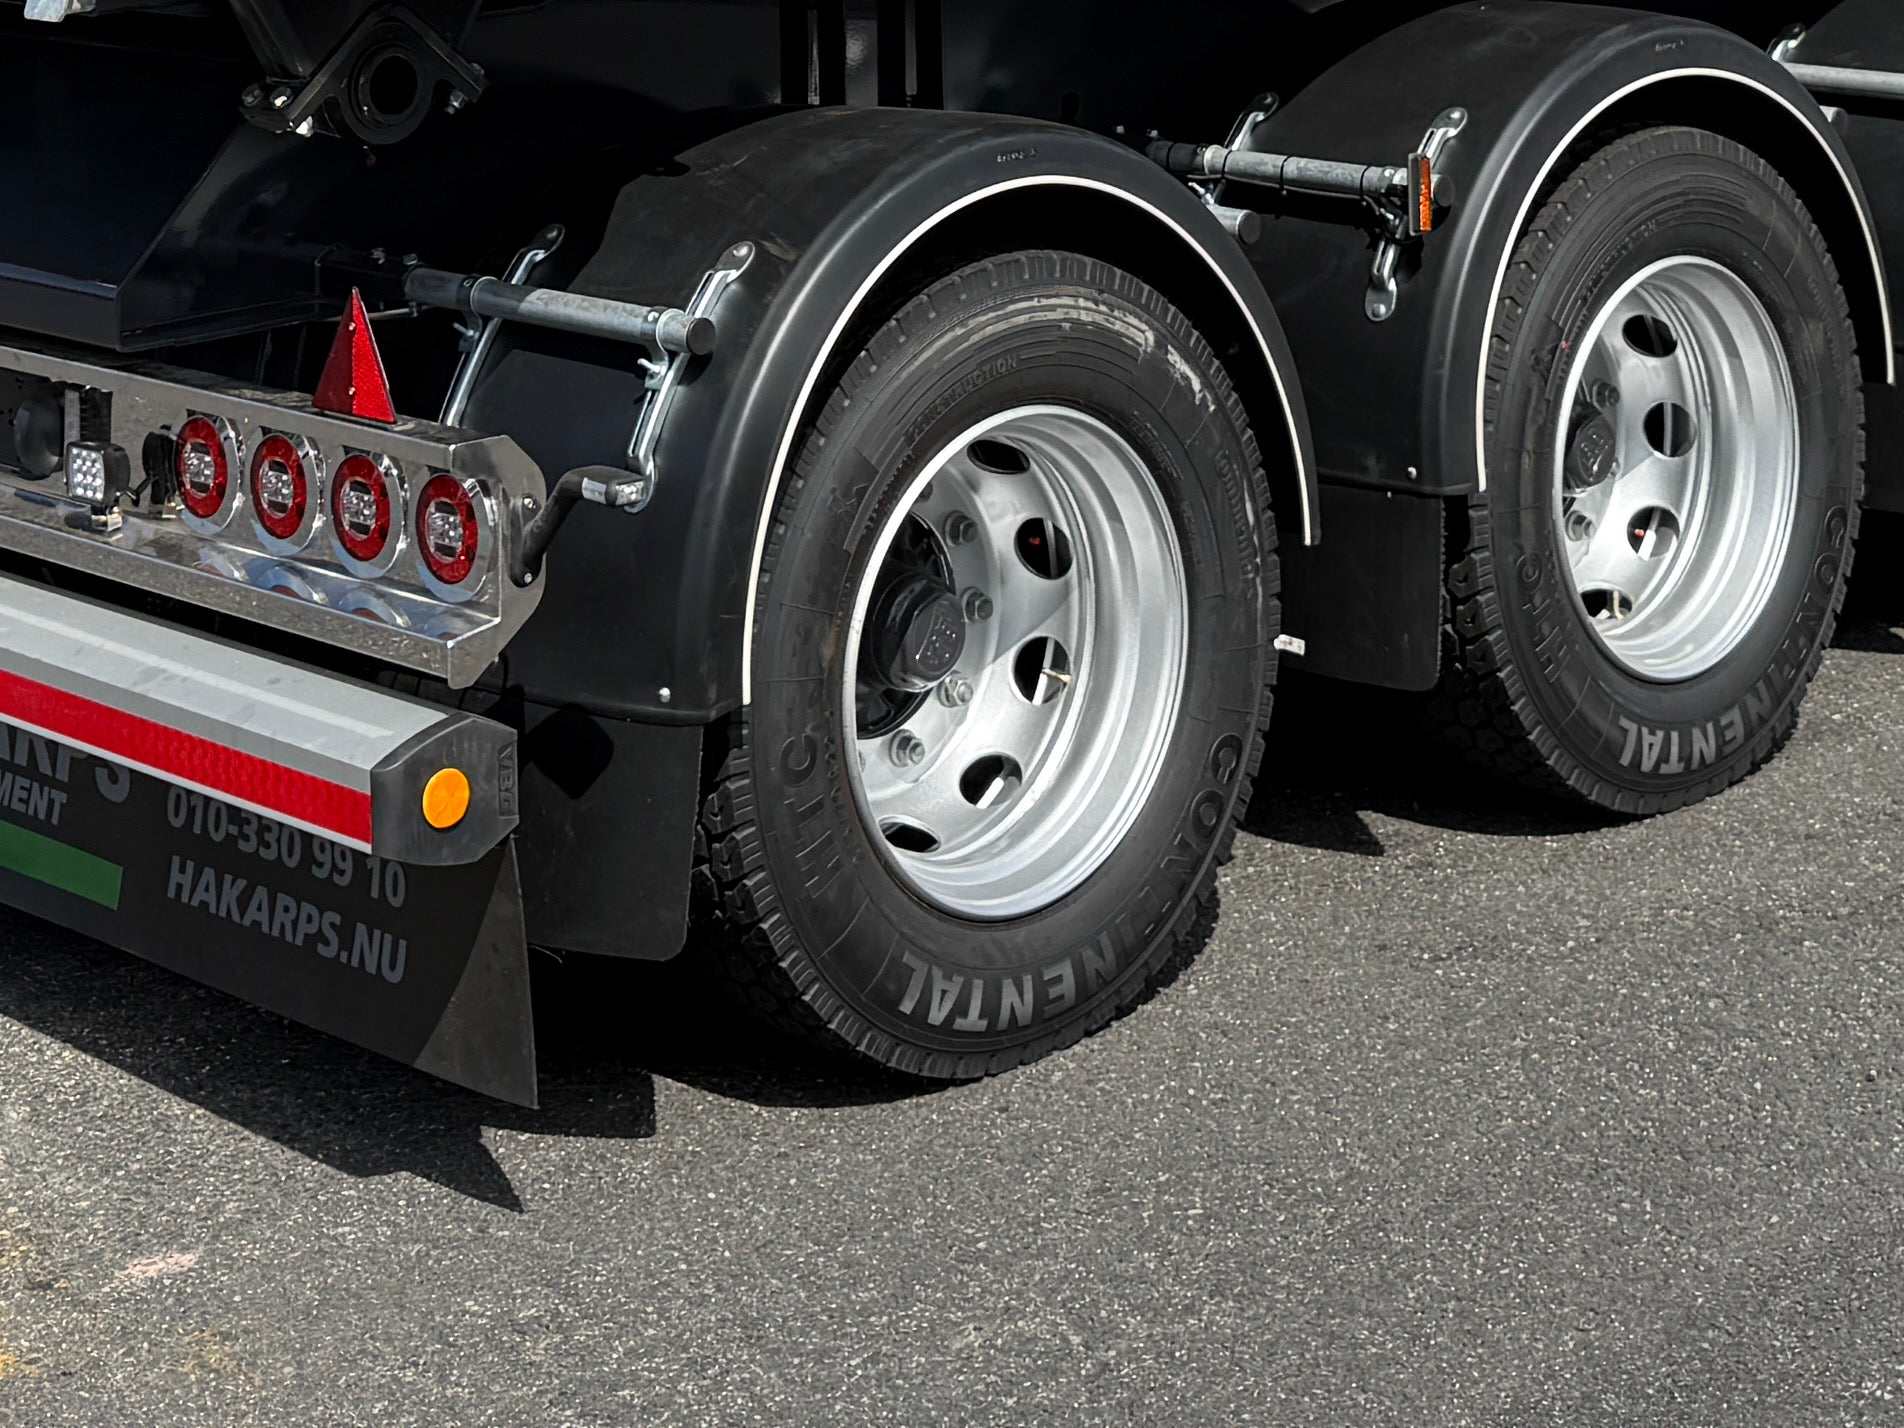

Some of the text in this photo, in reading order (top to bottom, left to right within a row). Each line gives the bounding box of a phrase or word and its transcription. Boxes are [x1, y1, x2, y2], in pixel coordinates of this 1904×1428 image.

[166, 785, 406, 908] 010-330 99 10
[166, 855, 408, 985] HAKARPS.NU
